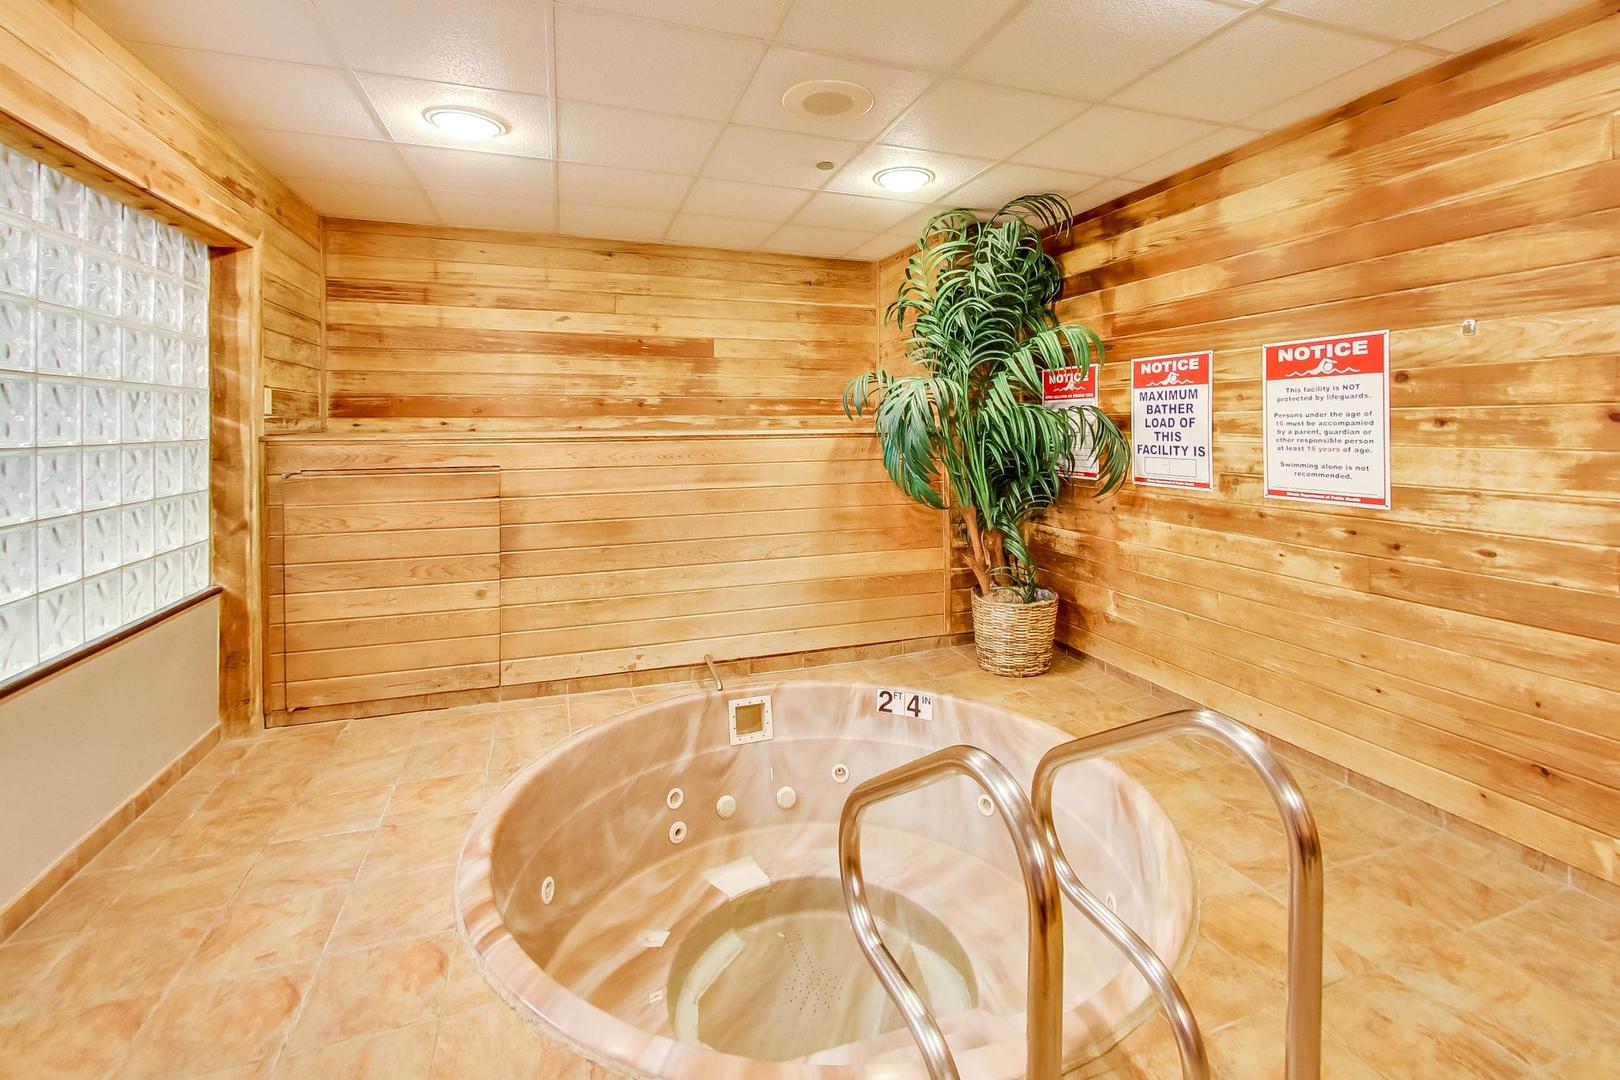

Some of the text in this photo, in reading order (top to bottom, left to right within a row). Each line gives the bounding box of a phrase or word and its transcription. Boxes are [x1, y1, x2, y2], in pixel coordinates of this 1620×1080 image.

[1278, 340, 1369, 362] NOTICE
[1141, 358, 1199, 374] NOTICE
[1303, 385, 1330, 393] facility
[1342, 383, 1361, 391] NOT
[1139, 388, 1198, 402] MAXIMUM
[1277, 395, 1313, 403] protected
[1326, 392, 1371, 401] lifeguards.
[1146, 403, 1194, 415] BATHER
[1345, 411, 1361, 419] age
[1145, 417, 1196, 428] LOAD OF
[1154, 431, 1182, 442] THIS
[1344, 438, 1374, 446] person
[1137, 444, 1206, 457] FACILITY IS
[1280, 461, 1319, 470] Swimming
[1320, 463, 1343, 471] alone
[1294, 471, 1353, 480] recommended.
[878, 690, 931, 718] 2 FT 4 IN
